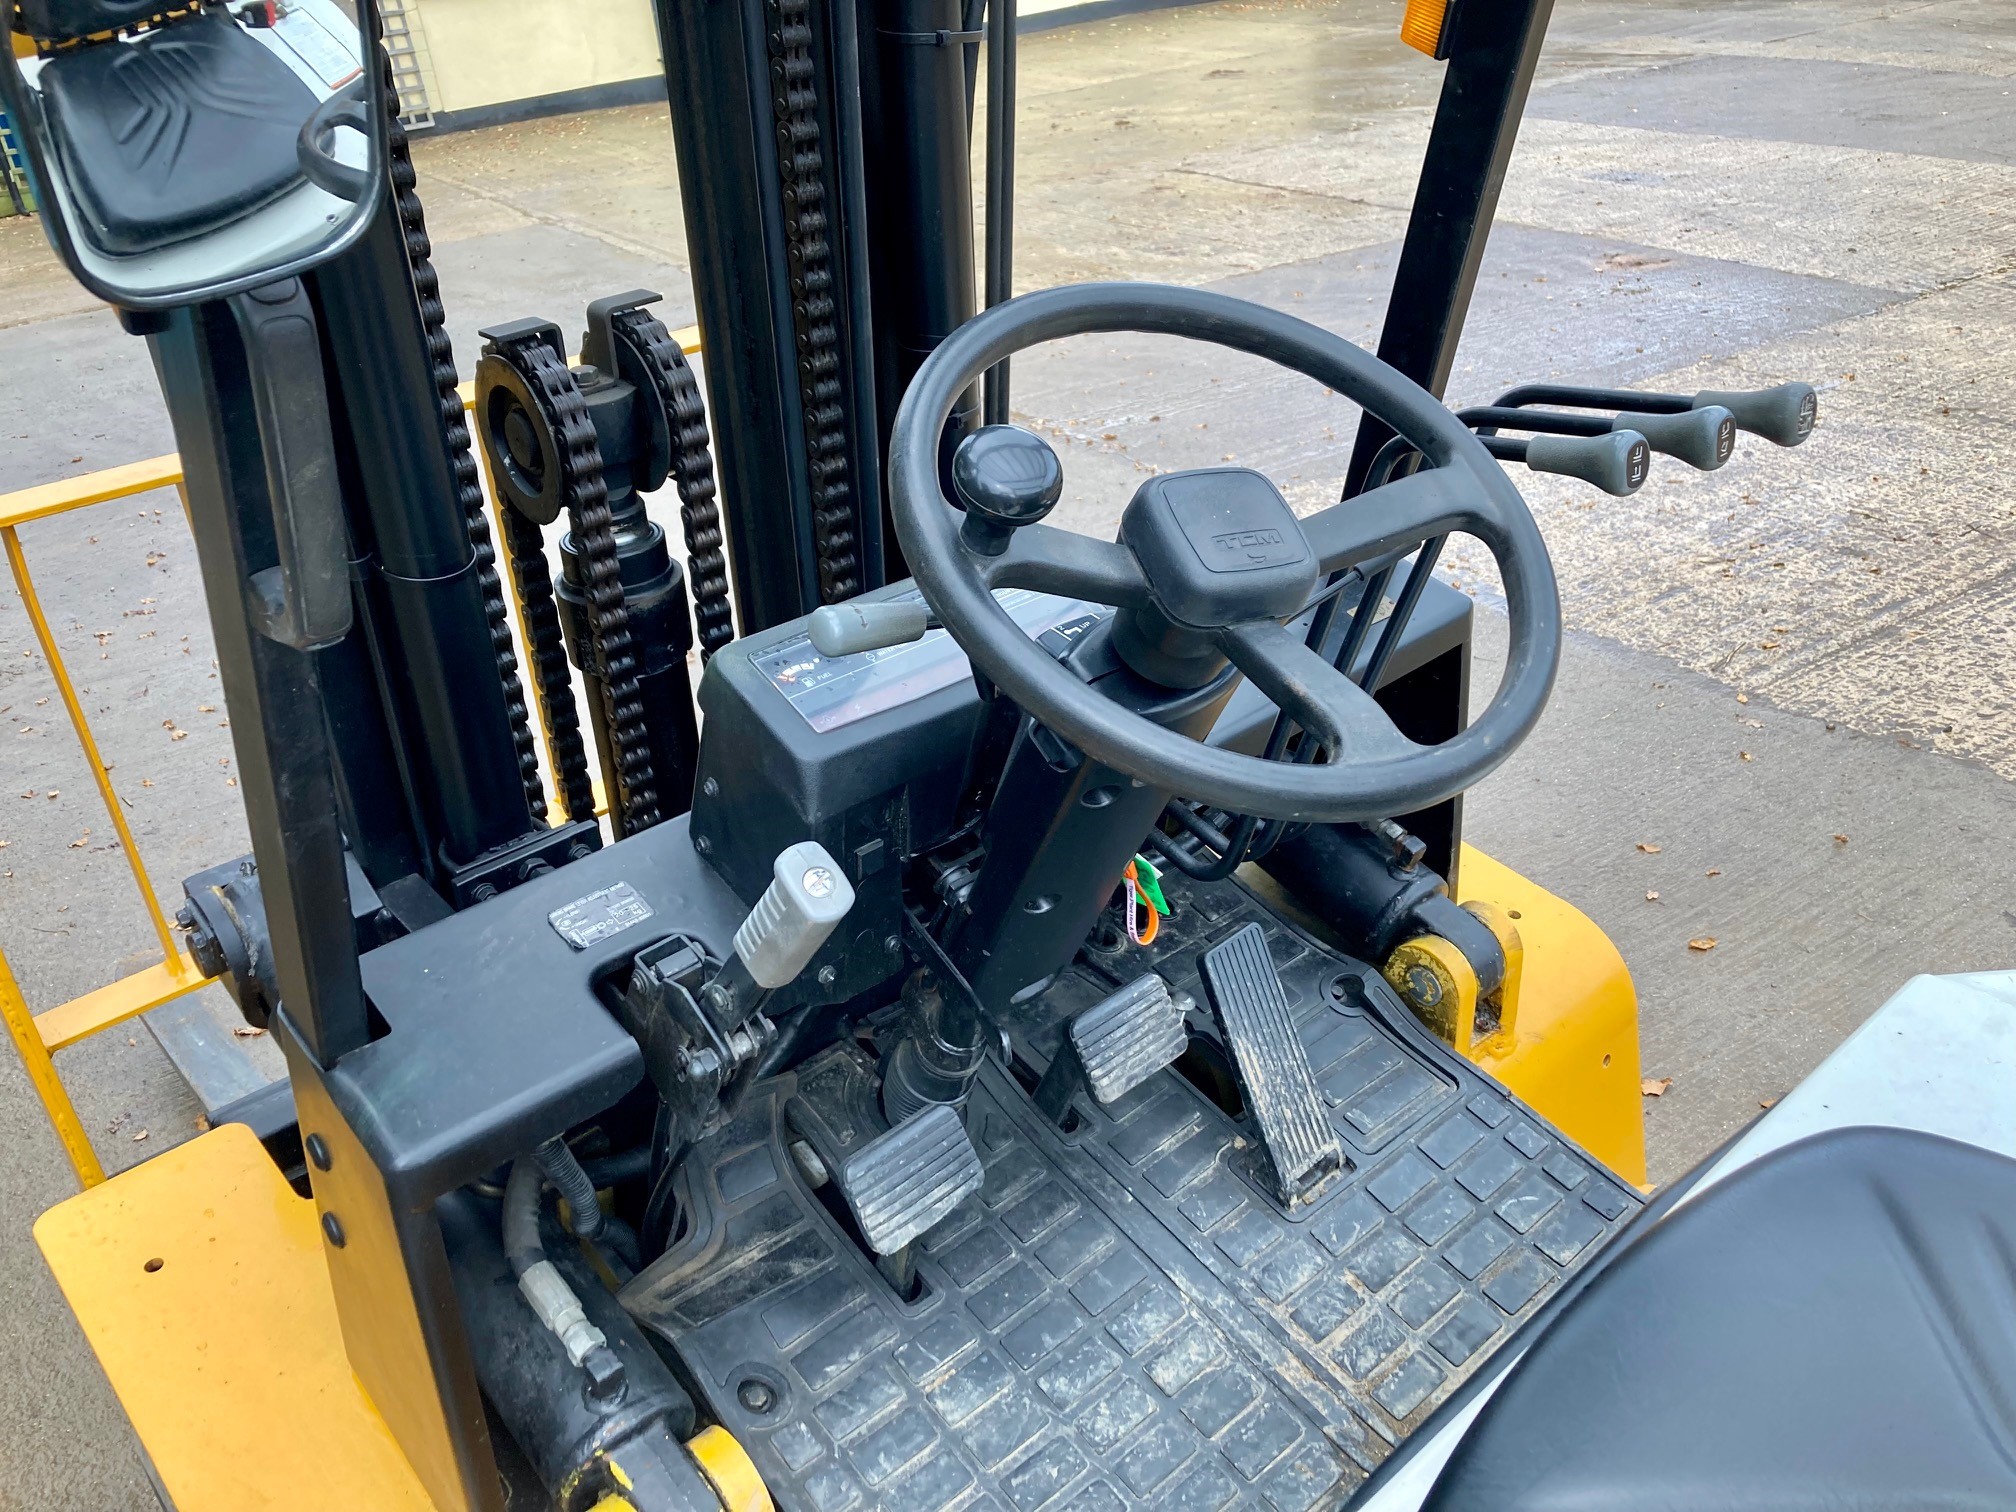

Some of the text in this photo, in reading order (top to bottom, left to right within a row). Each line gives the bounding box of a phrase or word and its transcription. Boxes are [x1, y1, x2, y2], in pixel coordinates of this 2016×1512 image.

[1216, 533, 1280, 549] TCM
[1079, 621, 1092, 629] UP
[817, 672, 832, 680] FUEL
